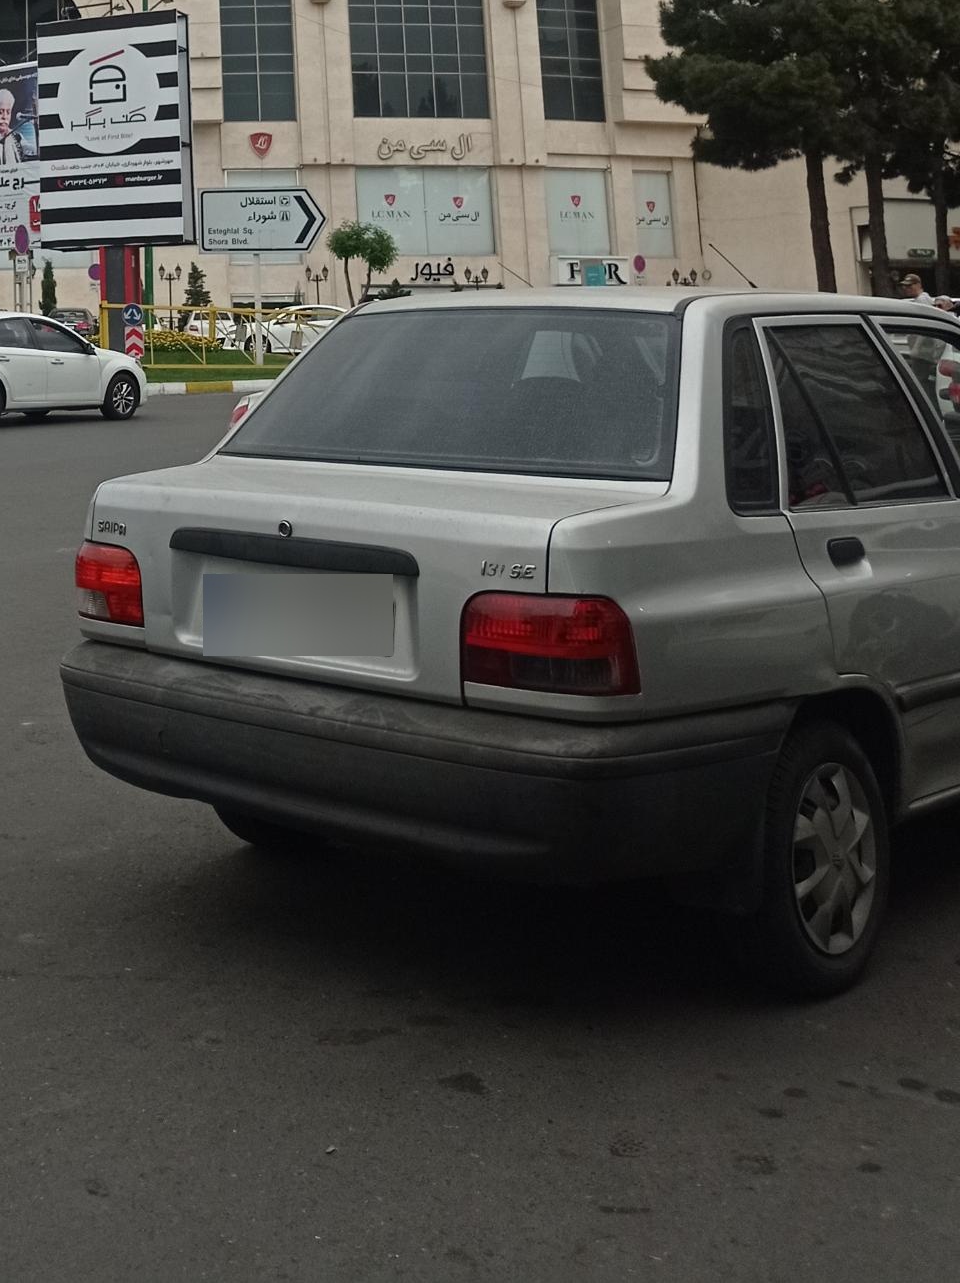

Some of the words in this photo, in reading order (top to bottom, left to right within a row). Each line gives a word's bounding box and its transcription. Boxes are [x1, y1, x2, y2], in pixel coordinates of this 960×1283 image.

[377, 137, 407, 161] من
[409, 139, 448, 161] سی
[450, 133, 473, 161] ال
[240, 196, 276, 207] استقلال
[438, 211, 451, 222] من
[207, 227, 240, 236] Esteghlal
[243, 227, 254, 236] Sq.
[231, 237, 249, 245] Blvd.
[410, 257, 455, 282] فیور
[97, 520, 127, 536] SAIPA
[509, 563, 537, 579] SE
